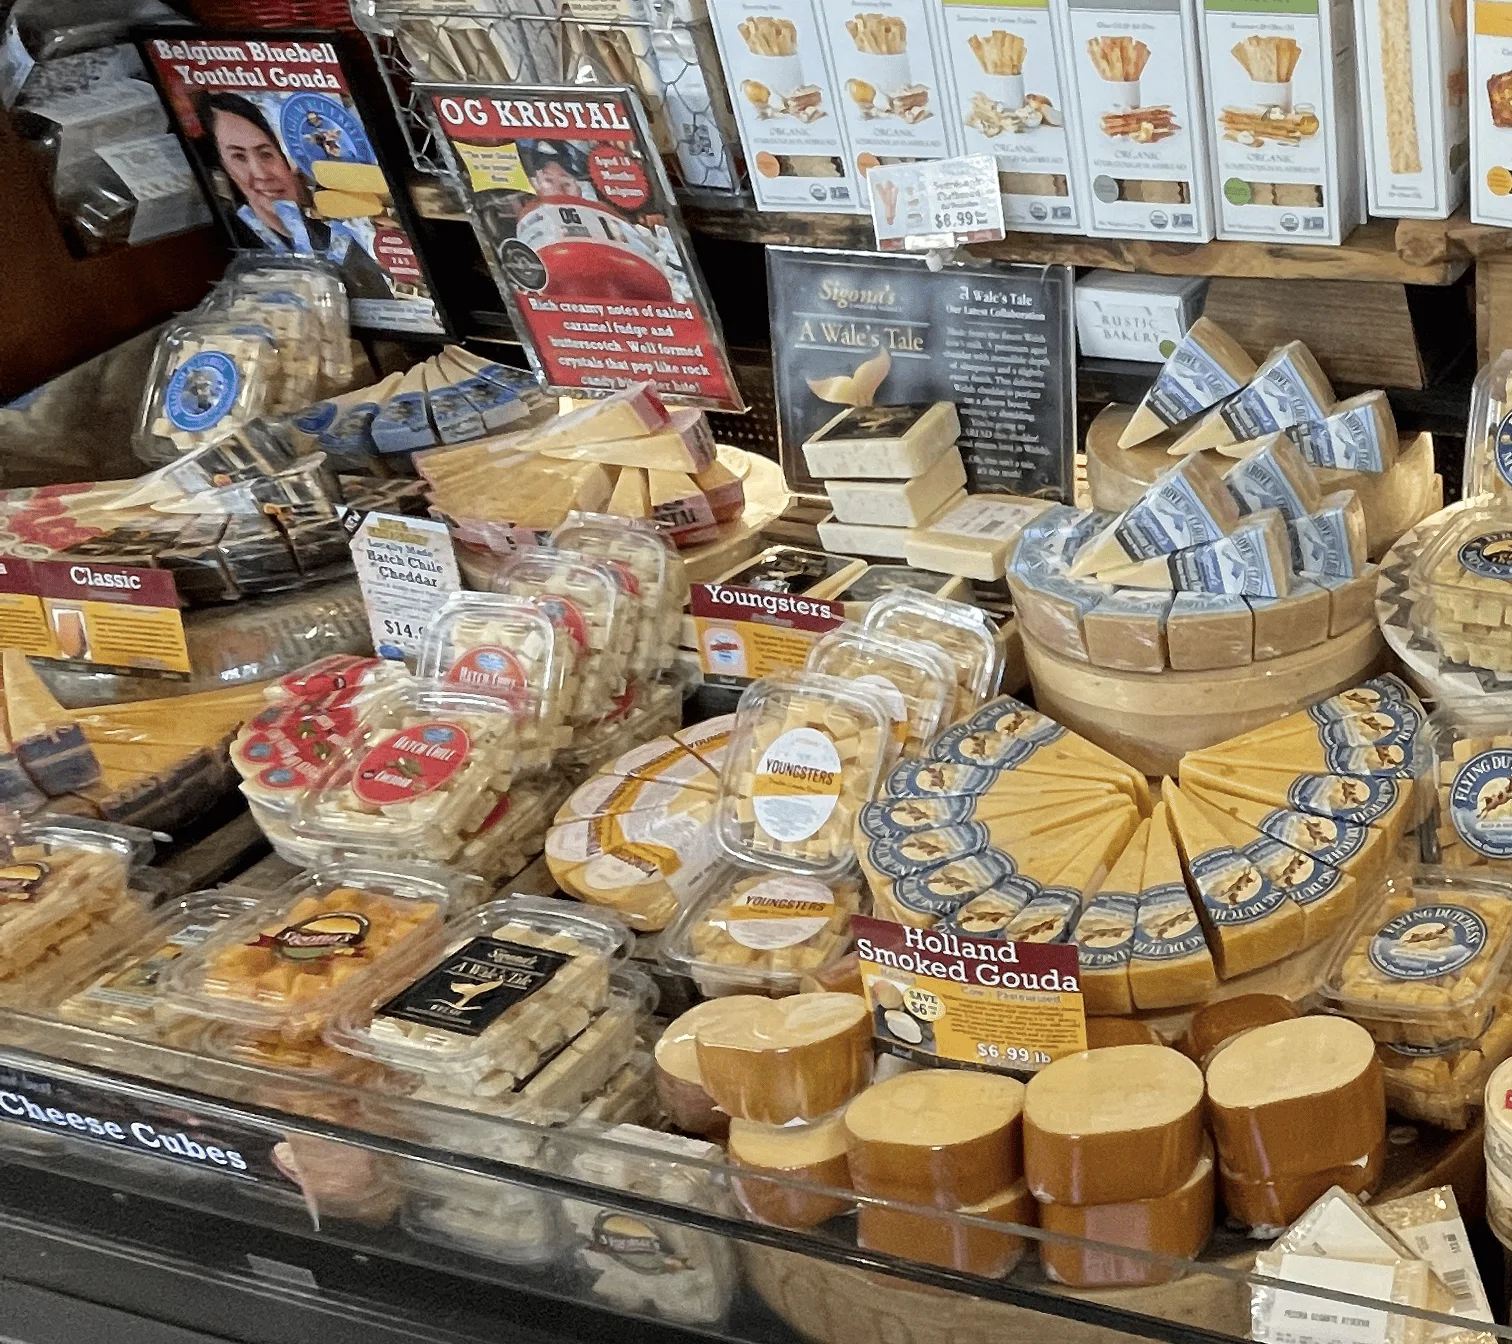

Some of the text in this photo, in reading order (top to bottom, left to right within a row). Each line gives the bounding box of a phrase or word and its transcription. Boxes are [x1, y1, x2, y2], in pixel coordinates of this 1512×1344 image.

[153, 39, 340, 66] Belgium Bluebell
[174, 64, 342, 89] Youthful Gouda
[440, 97, 632, 130] OG KRISTAL
[559, 207, 582, 225] OG
[560, 302, 604, 317] creamy
[607, 304, 640, 318] notes
[641, 305, 655, 318] of
[655, 307, 695, 321] salted
[563, 321, 675, 338] caramel fudge and
[799, 321, 924, 352] A Wale's Tale
[626, 340, 657, 355] Well
[657, 342, 704, 357] formed
[605, 358, 630, 371] that
[631, 362, 654, 375] pop
[654, 360, 681, 374] like
[682, 363, 711, 376] rock
[367, 549, 443, 574] Hatch Chile
[70, 566, 142, 590] Classic
[379, 566, 437, 588] Cheddar
[703, 583, 833, 620] Youngsters
[765, 758, 835, 786] YOUNGSTERS
[1454, 757, 1492, 803] FLYING
[902, 925, 1020, 964] Holland
[857, 938, 1081, 992] Smoked Gouda
[909, 990, 939, 1005] SAVE
[911, 1001, 929, 1016] $6
[976, 1042, 1052, 1064] $6.99 lb
[0, 1090, 248, 1170] Cheese Cubes
